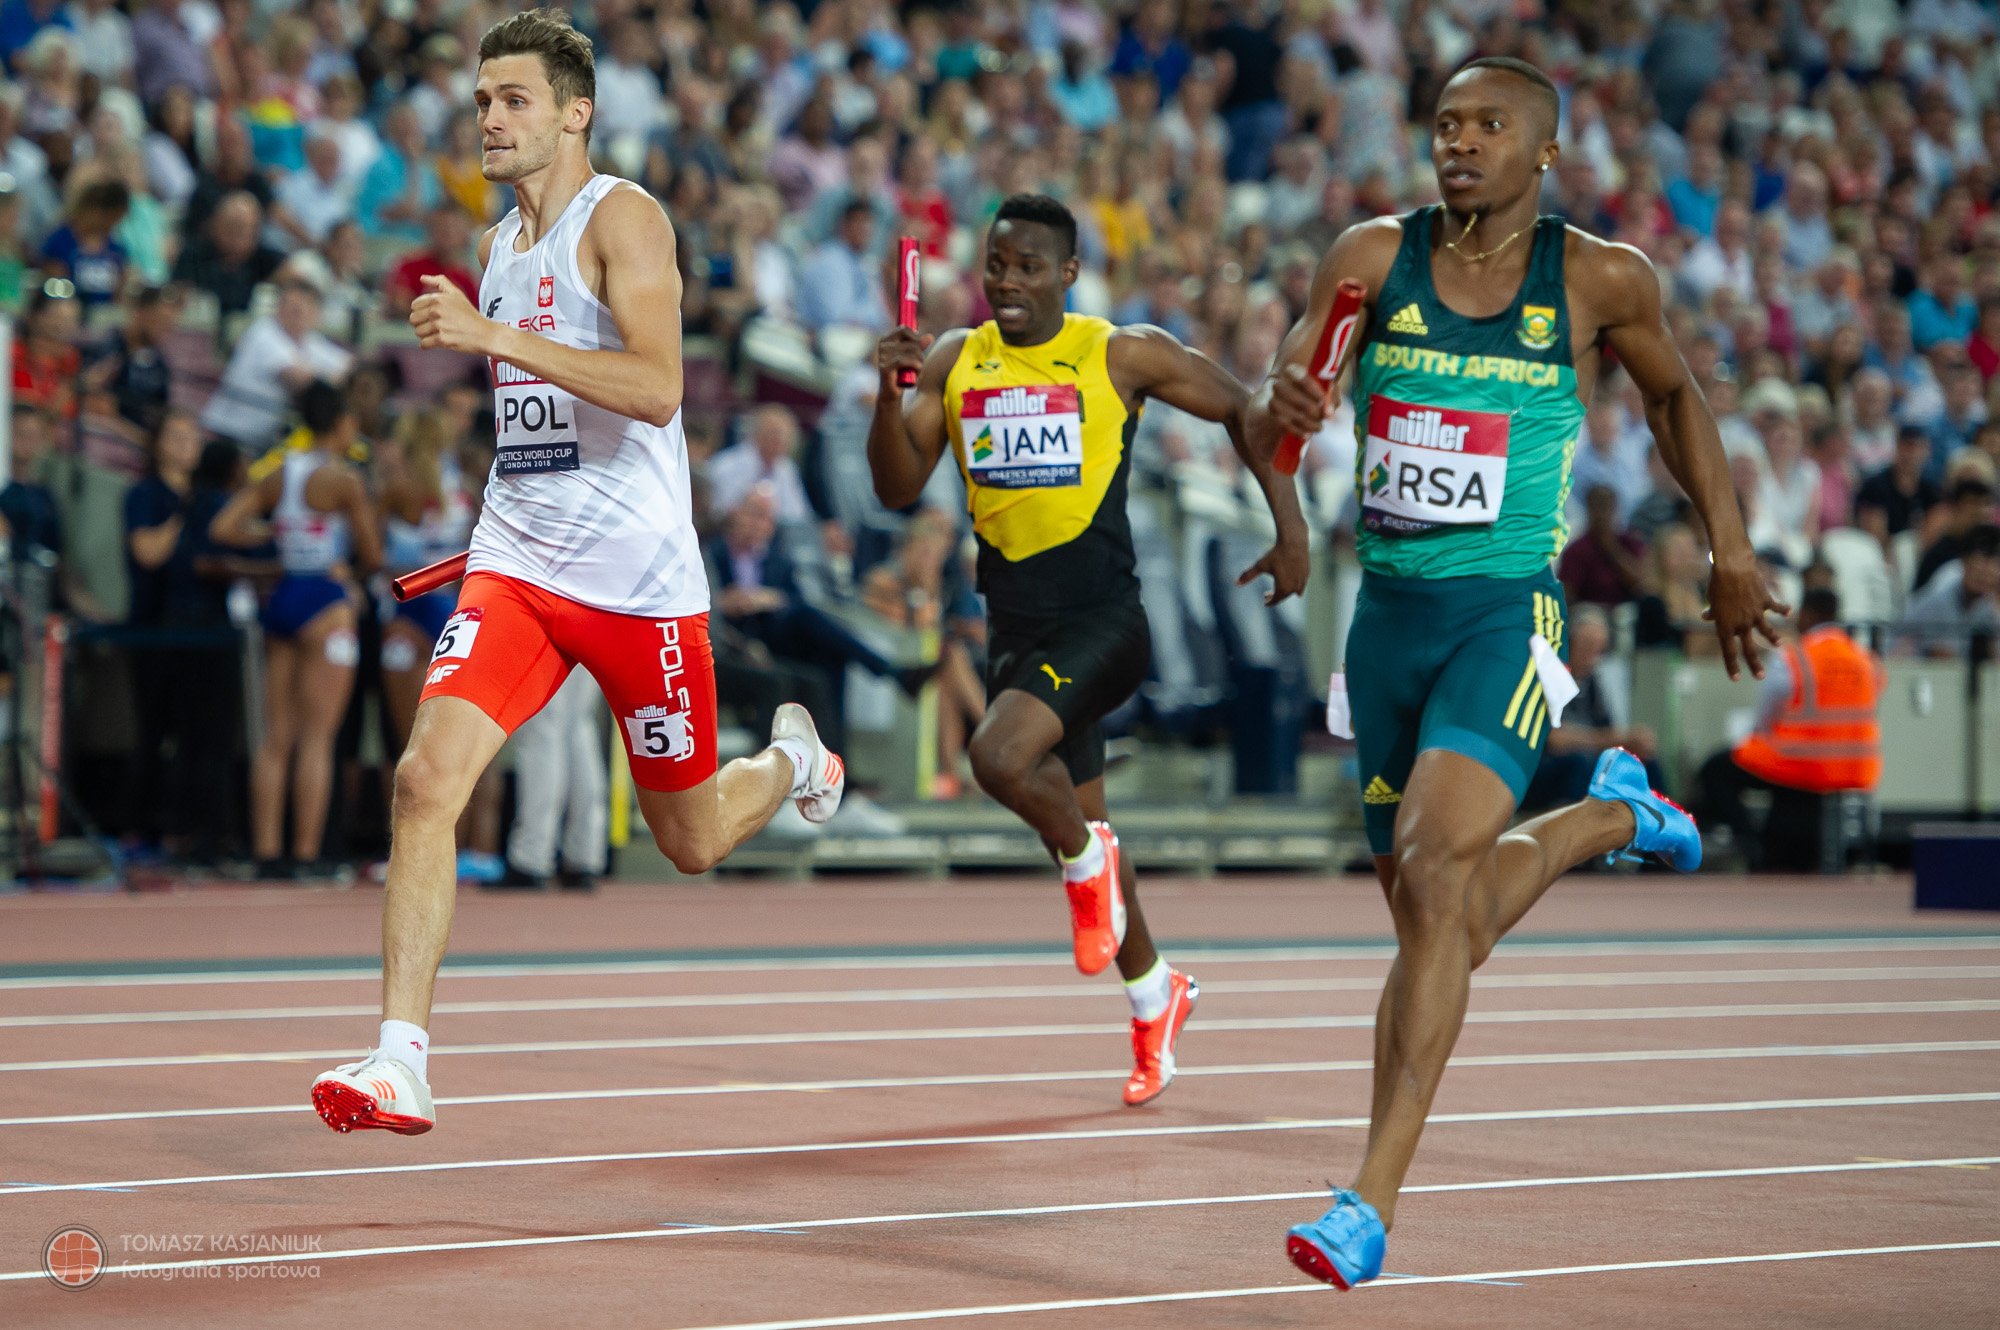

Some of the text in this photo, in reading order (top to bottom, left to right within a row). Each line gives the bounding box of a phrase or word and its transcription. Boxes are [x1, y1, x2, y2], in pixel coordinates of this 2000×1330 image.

[502, 314, 556, 334] SKA
[1386, 320, 1429, 336] adidas
[1374, 343, 1560, 387] SOUTH AFRICA
[504, 395, 569, 434] POL
[984, 387, 1049, 417] müller
[1004, 425, 1068, 463] JAM
[1388, 410, 1470, 451] müller
[504, 461, 532, 469] LONDON
[523, 449, 553, 460] WORLD
[554, 448, 573, 458] CUP
[1399, 462, 1488, 509] RSA
[435, 625, 460, 657] 5
[634, 705, 668, 719] müller
[644, 720, 670, 755] 5
